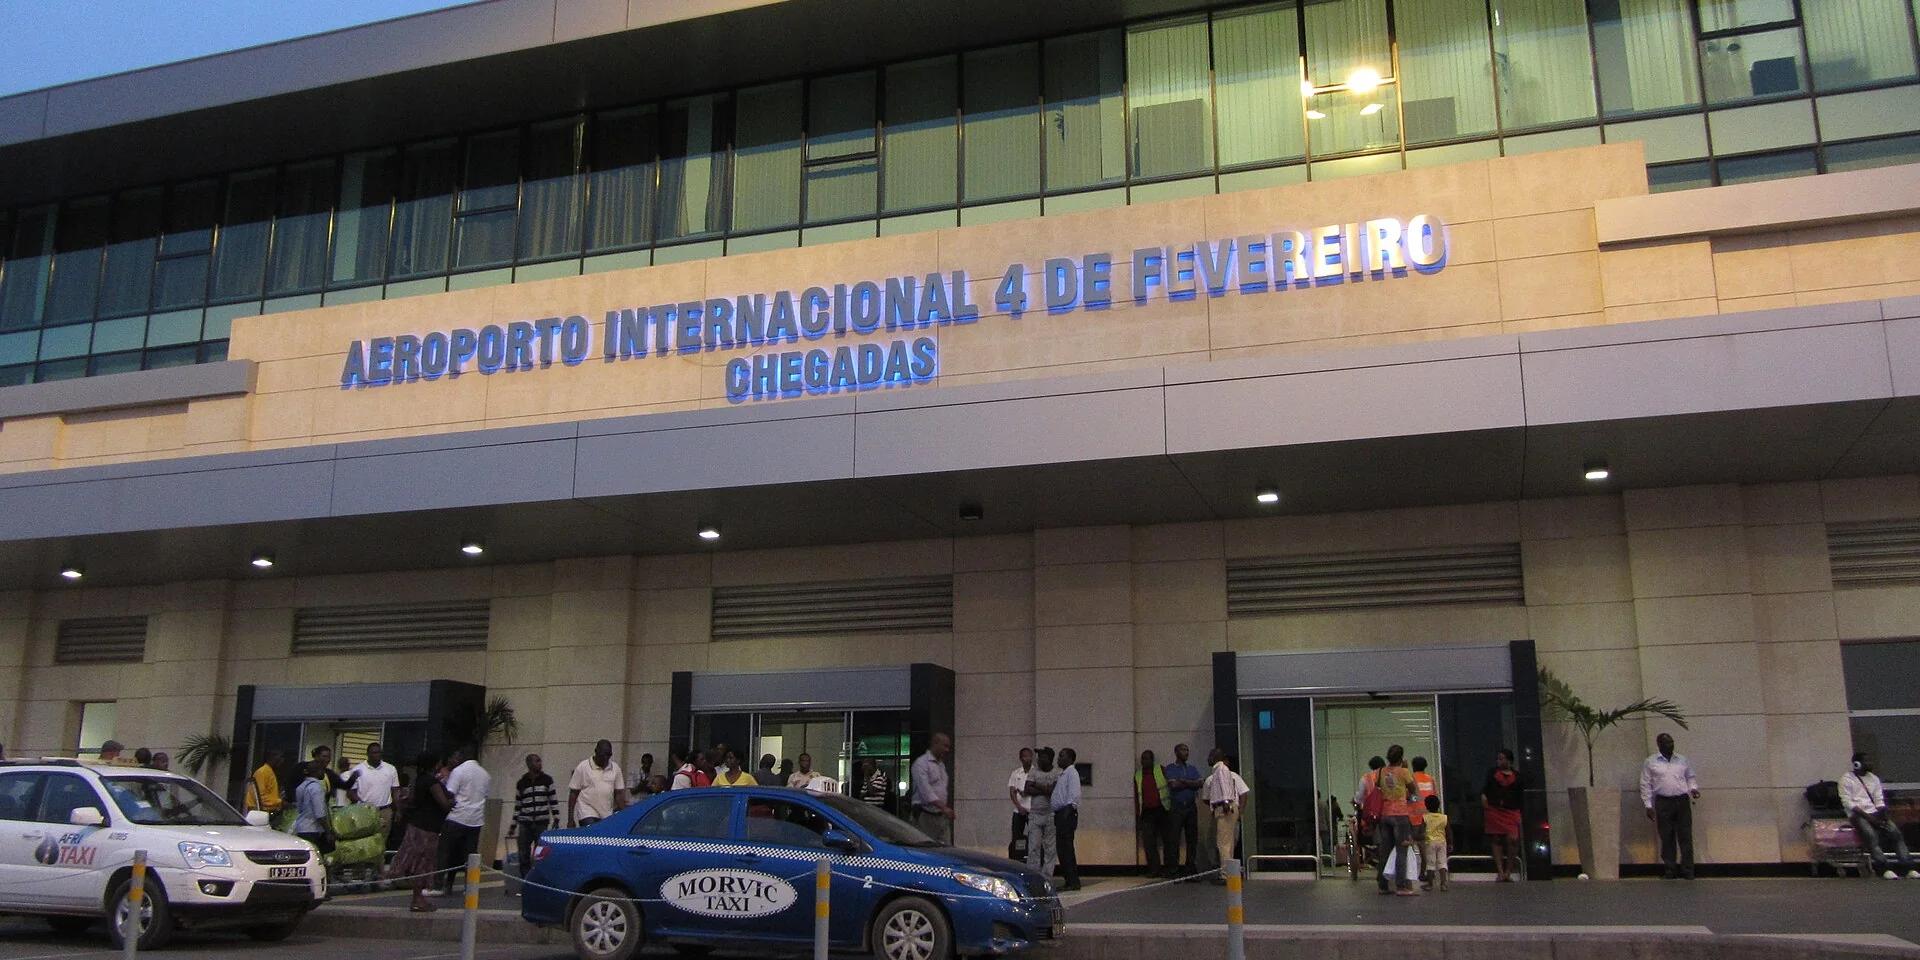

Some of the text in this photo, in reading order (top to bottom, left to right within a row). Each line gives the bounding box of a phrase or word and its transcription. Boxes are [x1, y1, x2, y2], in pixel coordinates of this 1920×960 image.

[341, 214, 1449, 390] AEROPORTO INTERNACIONAL 4 DE FEVEREIRO
[724, 336, 938, 404] CHEGADAS
[823, 781, 838, 793] TAXI
[59, 833, 84, 844] AFRI
[59, 845, 97, 865] TAXI
[678, 876, 778, 903] MORVIC
[863, 875, 873, 889] 2
[704, 895, 750, 912] TAXI
